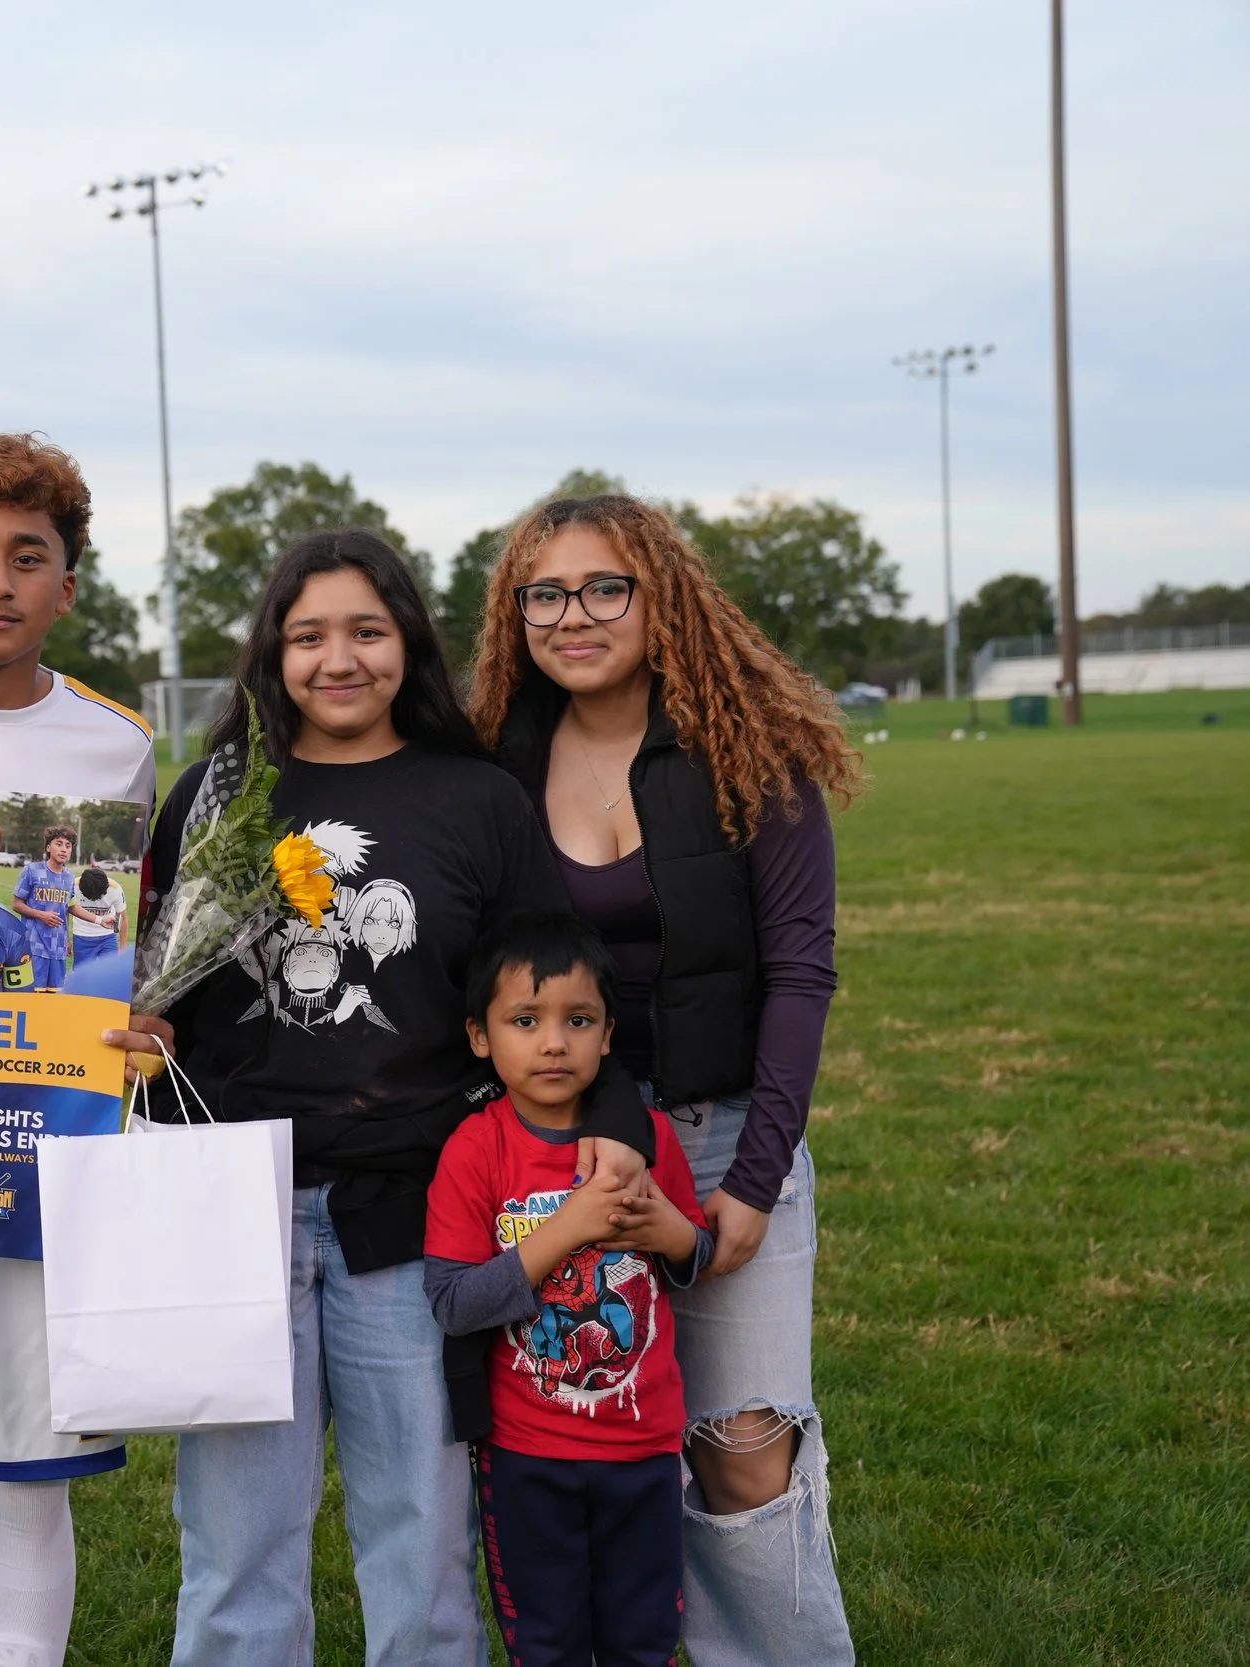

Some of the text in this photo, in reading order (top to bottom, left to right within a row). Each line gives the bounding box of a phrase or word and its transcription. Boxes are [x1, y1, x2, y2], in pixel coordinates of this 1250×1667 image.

[6, 969, 21, 986] C
[46, 1062, 86, 1077] 2026
[505, 1199, 527, 1213] the
[498, 1214, 550, 1246] SPI
